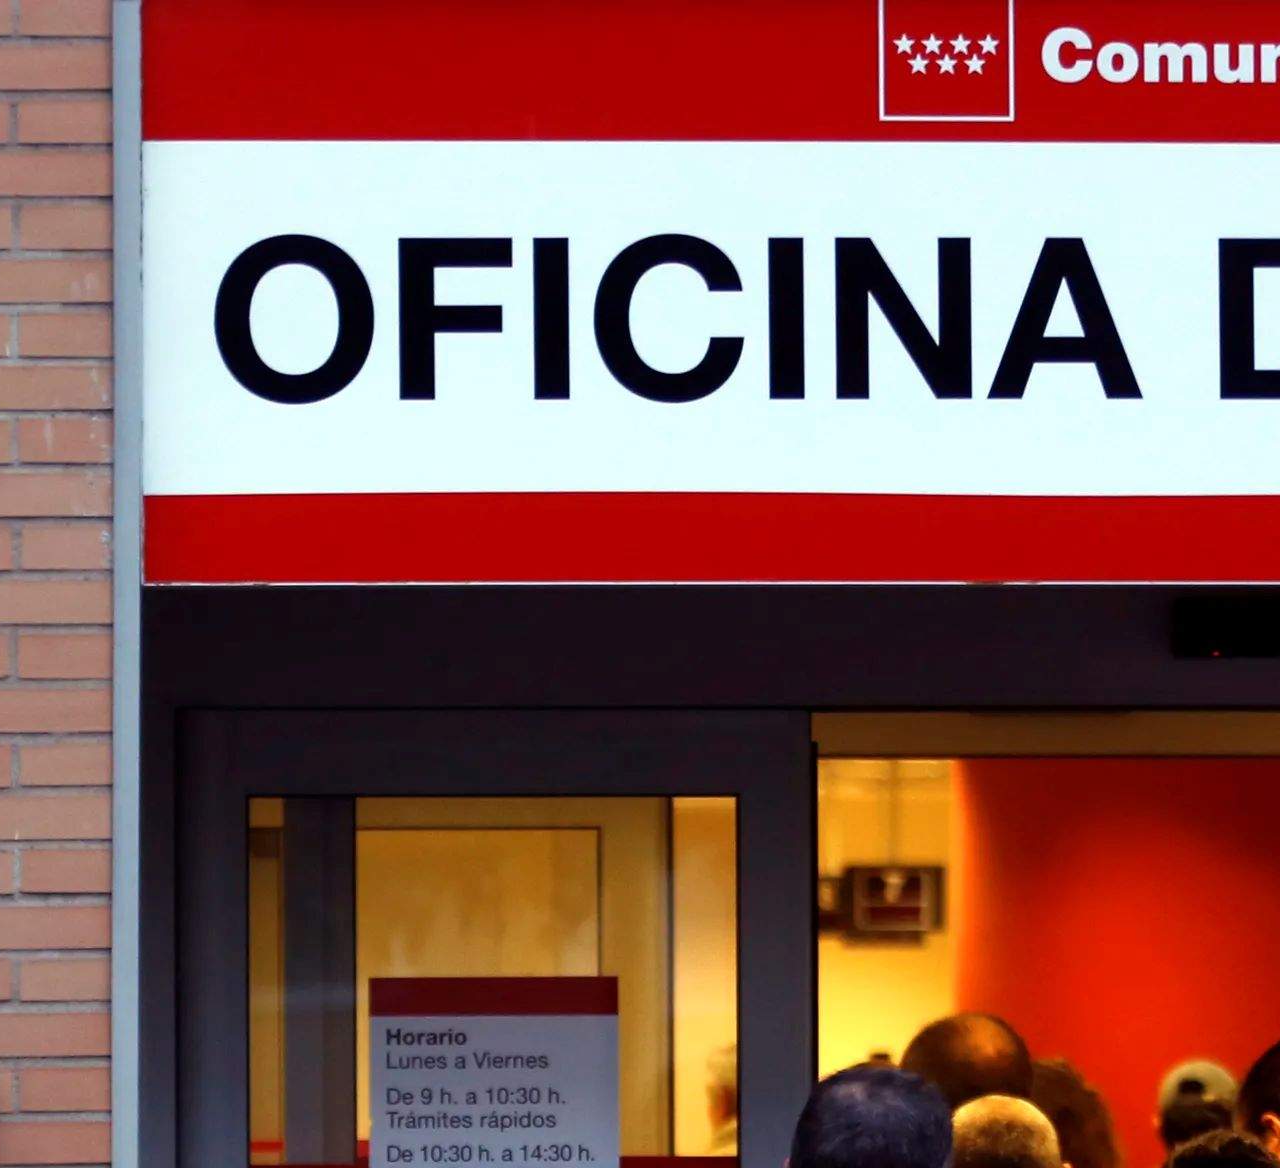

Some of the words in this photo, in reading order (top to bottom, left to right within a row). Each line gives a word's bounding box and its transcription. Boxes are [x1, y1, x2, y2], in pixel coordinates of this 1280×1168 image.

[212, 232, 1144, 406] OFICINA
[386, 1028, 467, 1046] Horario
[386, 1052, 448, 1070] Lunes
[454, 1056, 466, 1070] a
[472, 1052, 549, 1070] Viernes
[386, 1087, 414, 1106] De
[420, 1087, 433, 1105] 9
[439, 1087, 458, 1105] h.
[465, 1091, 477, 1105] a
[485, 1086, 541, 1105] 10:30
[548, 1086, 566, 1104] h.
[385, 1111, 473, 1129] Trámites
[479, 1110, 557, 1133] rápidos
[386, 1144, 414, 1163] De
[420, 1144, 473, 1163] 10:30
[478, 1144, 495, 1162] h.
[501, 1148, 513, 1162] a
[520, 1144, 573, 1162] 14:30
[577, 1144, 595, 1162] h.
